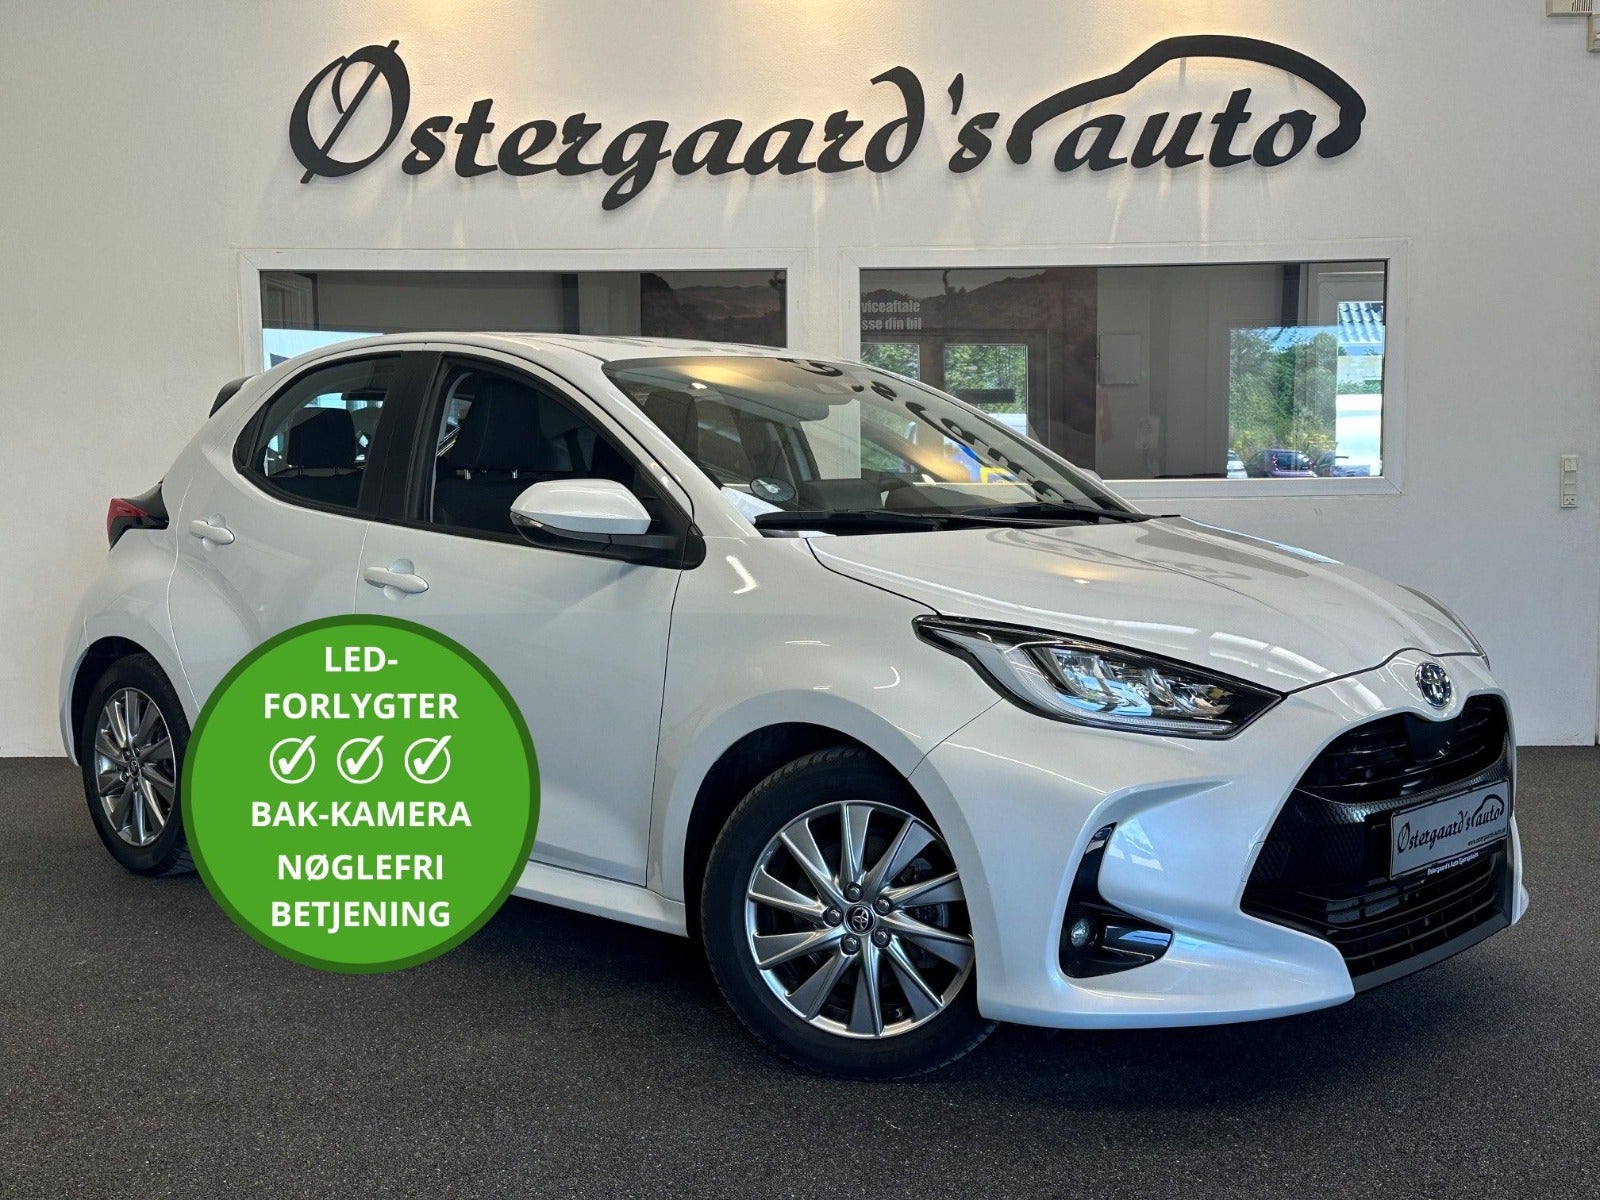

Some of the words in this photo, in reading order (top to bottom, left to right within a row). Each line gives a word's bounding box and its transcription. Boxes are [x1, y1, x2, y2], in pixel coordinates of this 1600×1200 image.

[289, 39, 1000, 211] Østergaard's
[1053, 87, 1317, 173] auto
[884, 317, 904, 330] din
[906, 317, 922, 330] bil
[1397, 810, 1470, 855] Østergaard's
[1475, 805, 1500, 827] auto
